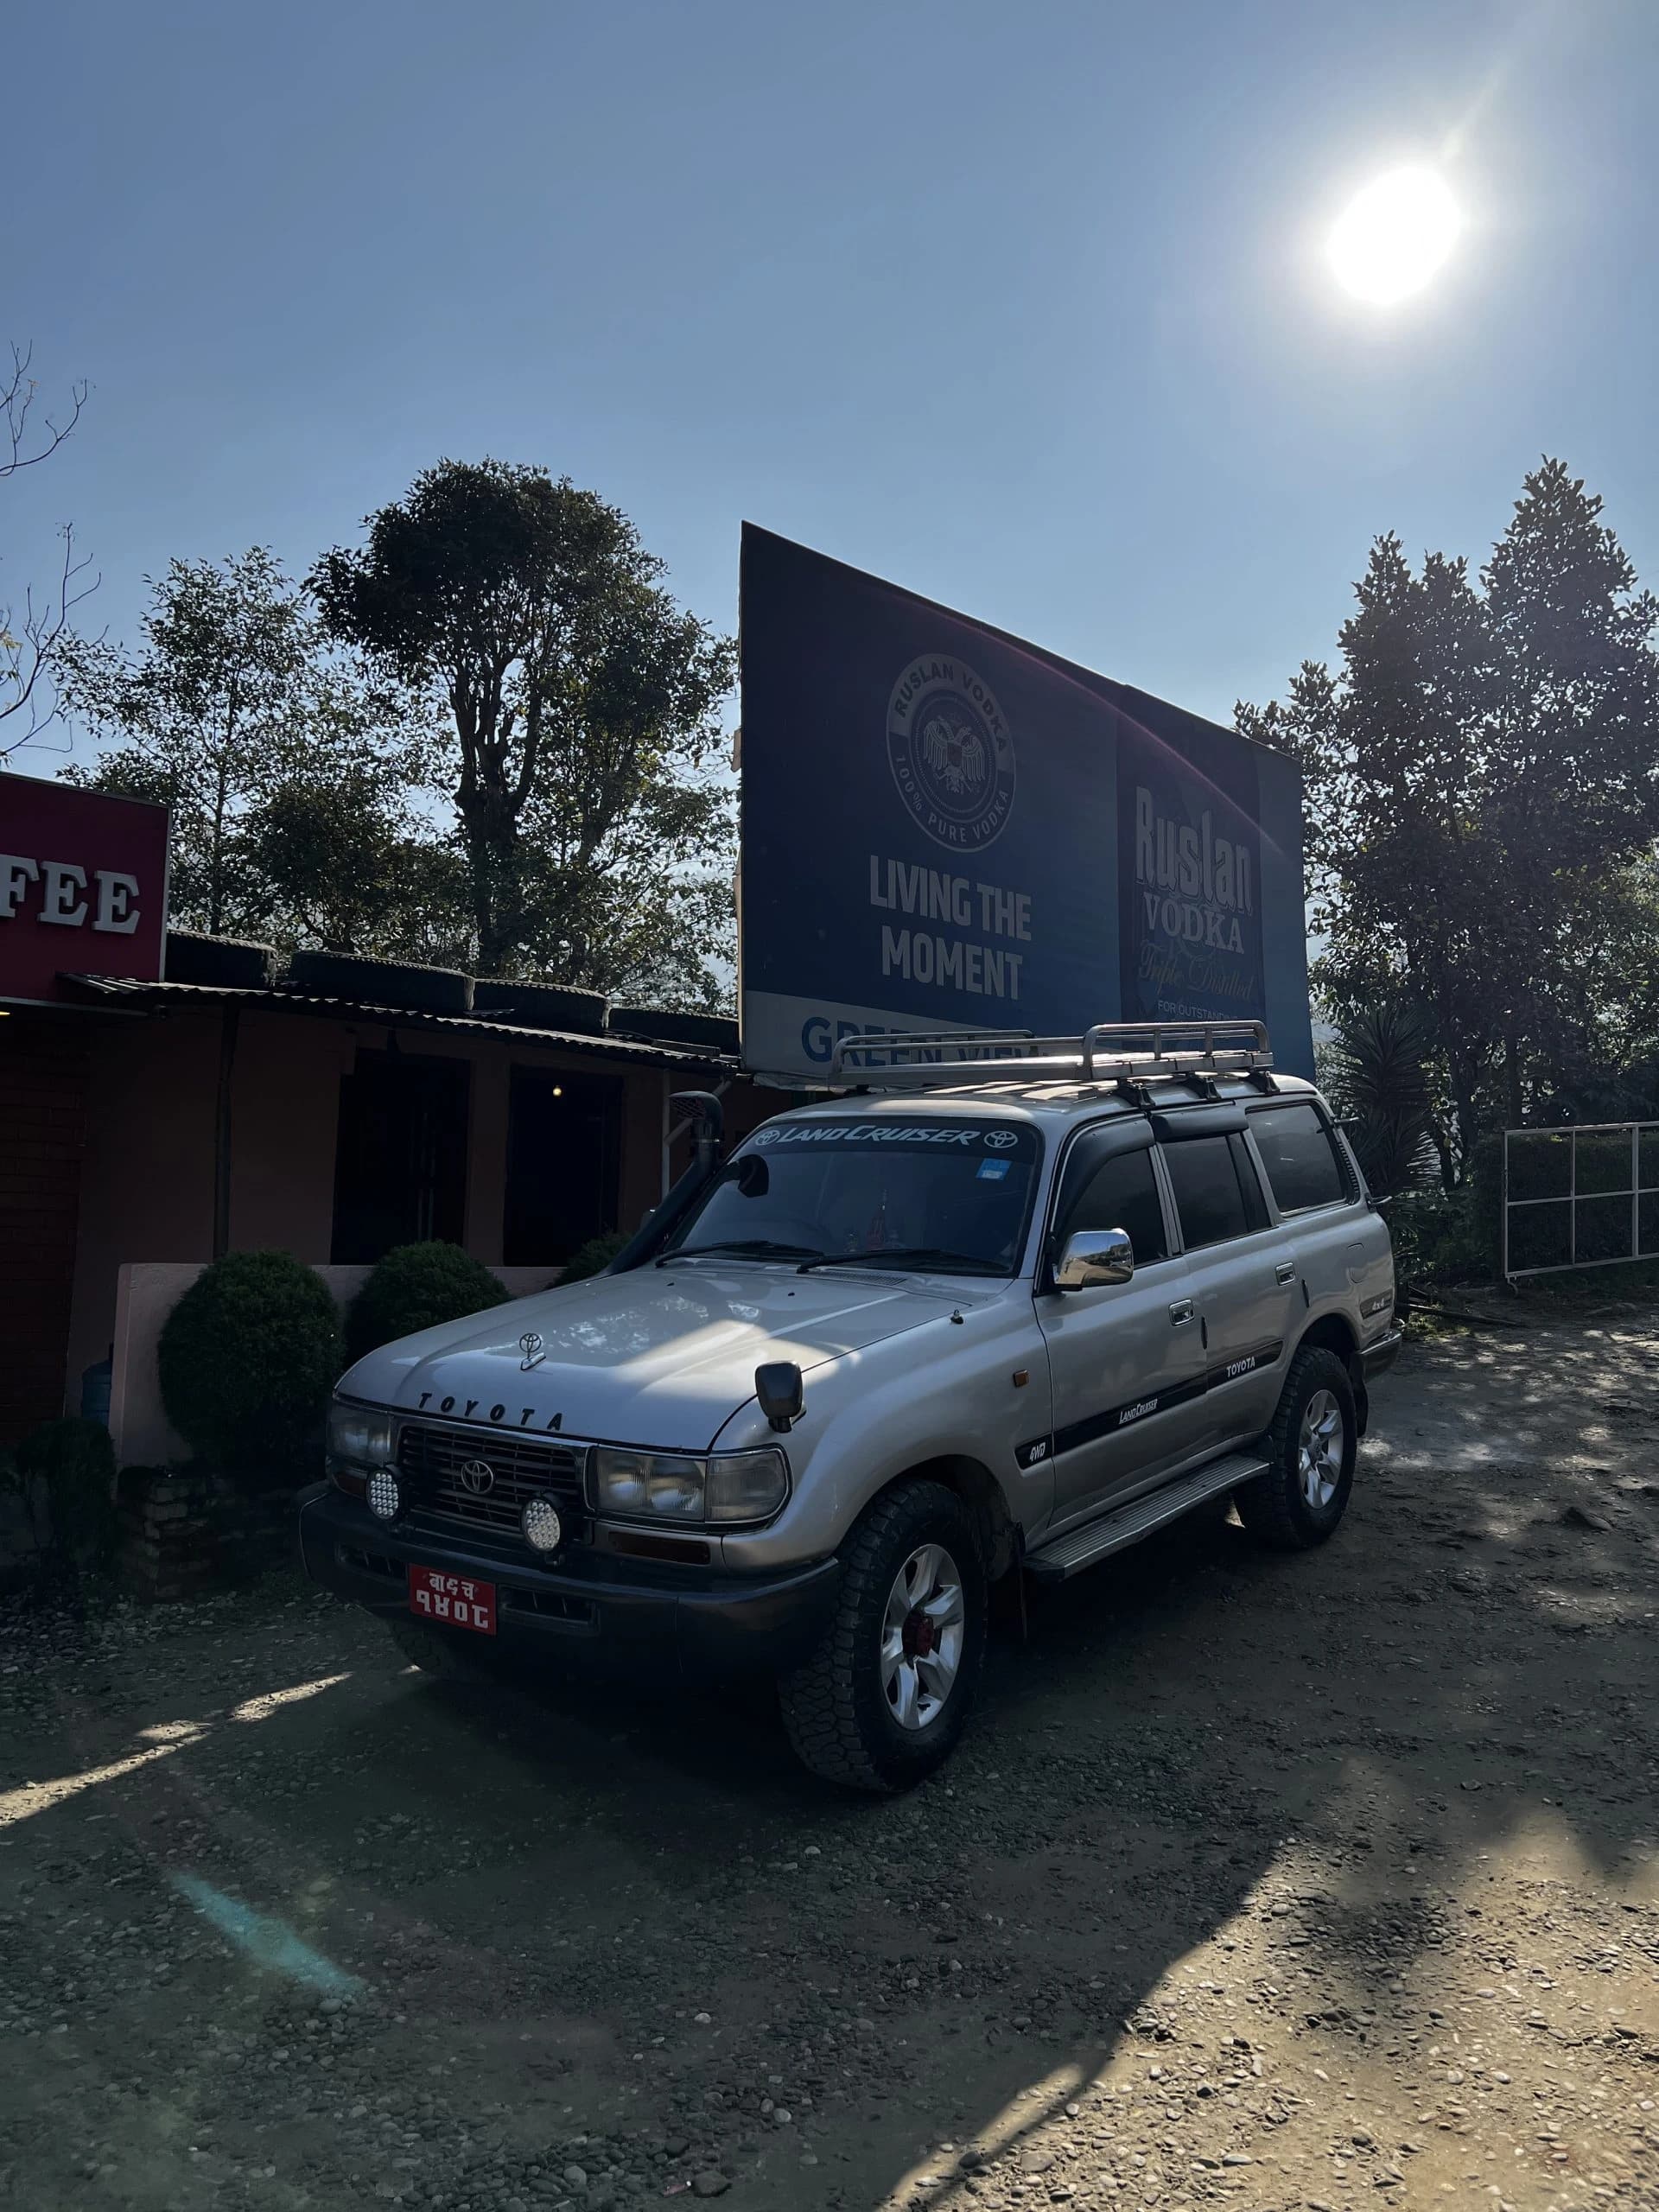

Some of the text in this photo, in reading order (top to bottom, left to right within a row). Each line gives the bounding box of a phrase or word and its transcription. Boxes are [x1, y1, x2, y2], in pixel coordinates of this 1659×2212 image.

[894, 662, 1007, 752] RUSLAN VODKA
[895, 754, 1009, 843] 100% PURE VODKA
[870, 855, 1032, 941] LIVING THE
[1143, 892, 1244, 954] VODKA
[881, 925, 1023, 1001] MOMENT
[1158, 1000, 1176, 1014] FOR
[1226, 1356, 1255, 1378] TOYOTA
[419, 1393, 563, 1431] TOYOTA
[1029, 1441, 1046, 1462] 4WD
